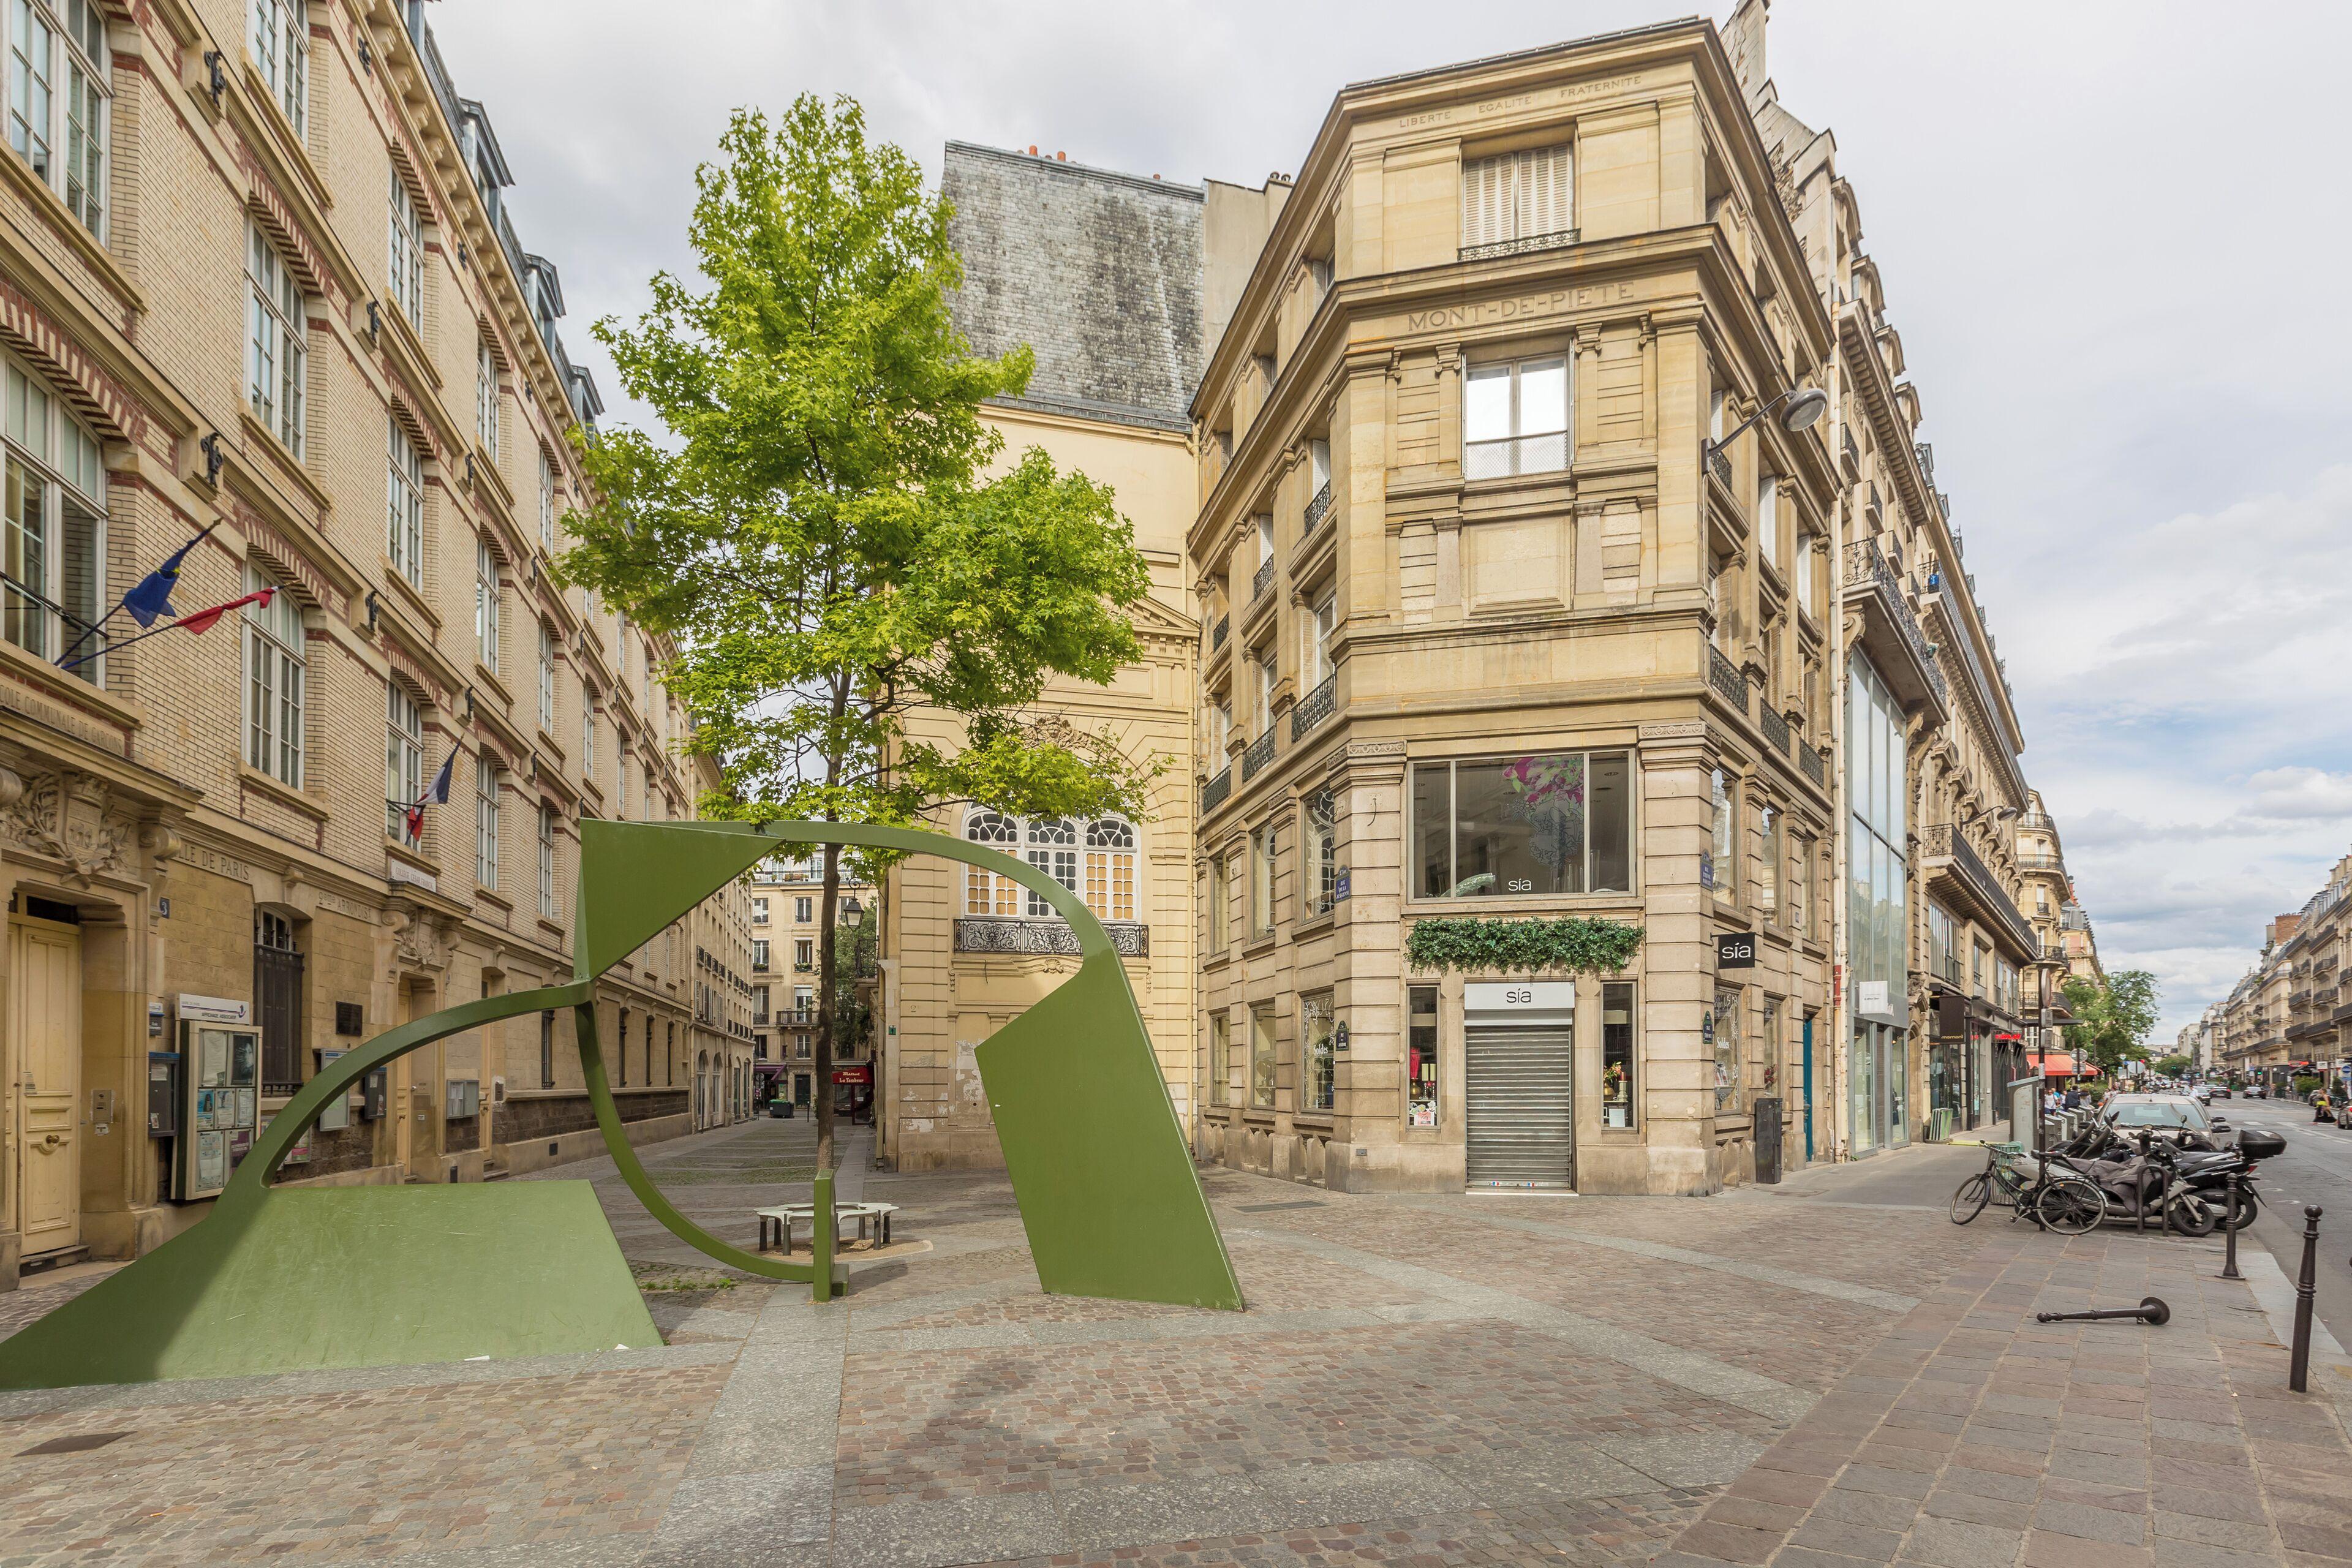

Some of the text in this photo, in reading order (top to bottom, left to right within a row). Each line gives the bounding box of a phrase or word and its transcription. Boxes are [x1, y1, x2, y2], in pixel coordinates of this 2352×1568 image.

[1400, 75, 1642, 128] LIBERTE EGALITE FRATERNITE
[202, 850, 215, 870] DE
[221, 857, 250, 881] PARIS
[161, 902, 167, 915] 3
[1313, 1043, 1329, 1055] Soldes
[1717, 1036, 1730, 1049] Soldes
